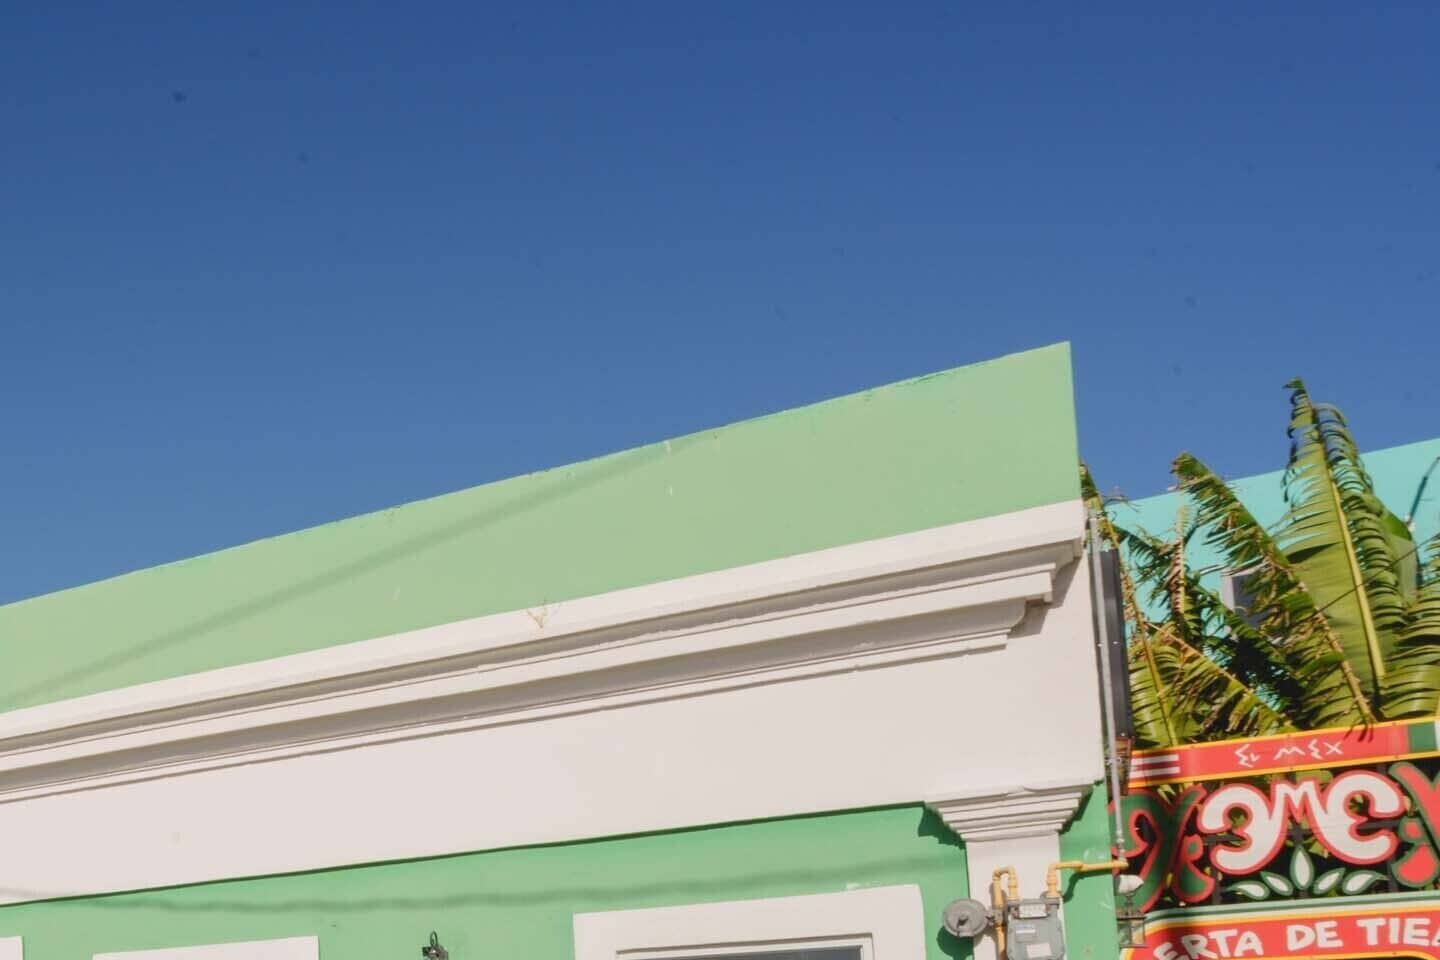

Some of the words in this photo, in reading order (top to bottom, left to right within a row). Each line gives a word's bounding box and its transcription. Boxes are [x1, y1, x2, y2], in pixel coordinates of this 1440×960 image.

[1273, 738, 1344, 761] MEX
[1286, 920, 1344, 951] DE
[1356, 915, 1440, 947] TIE
